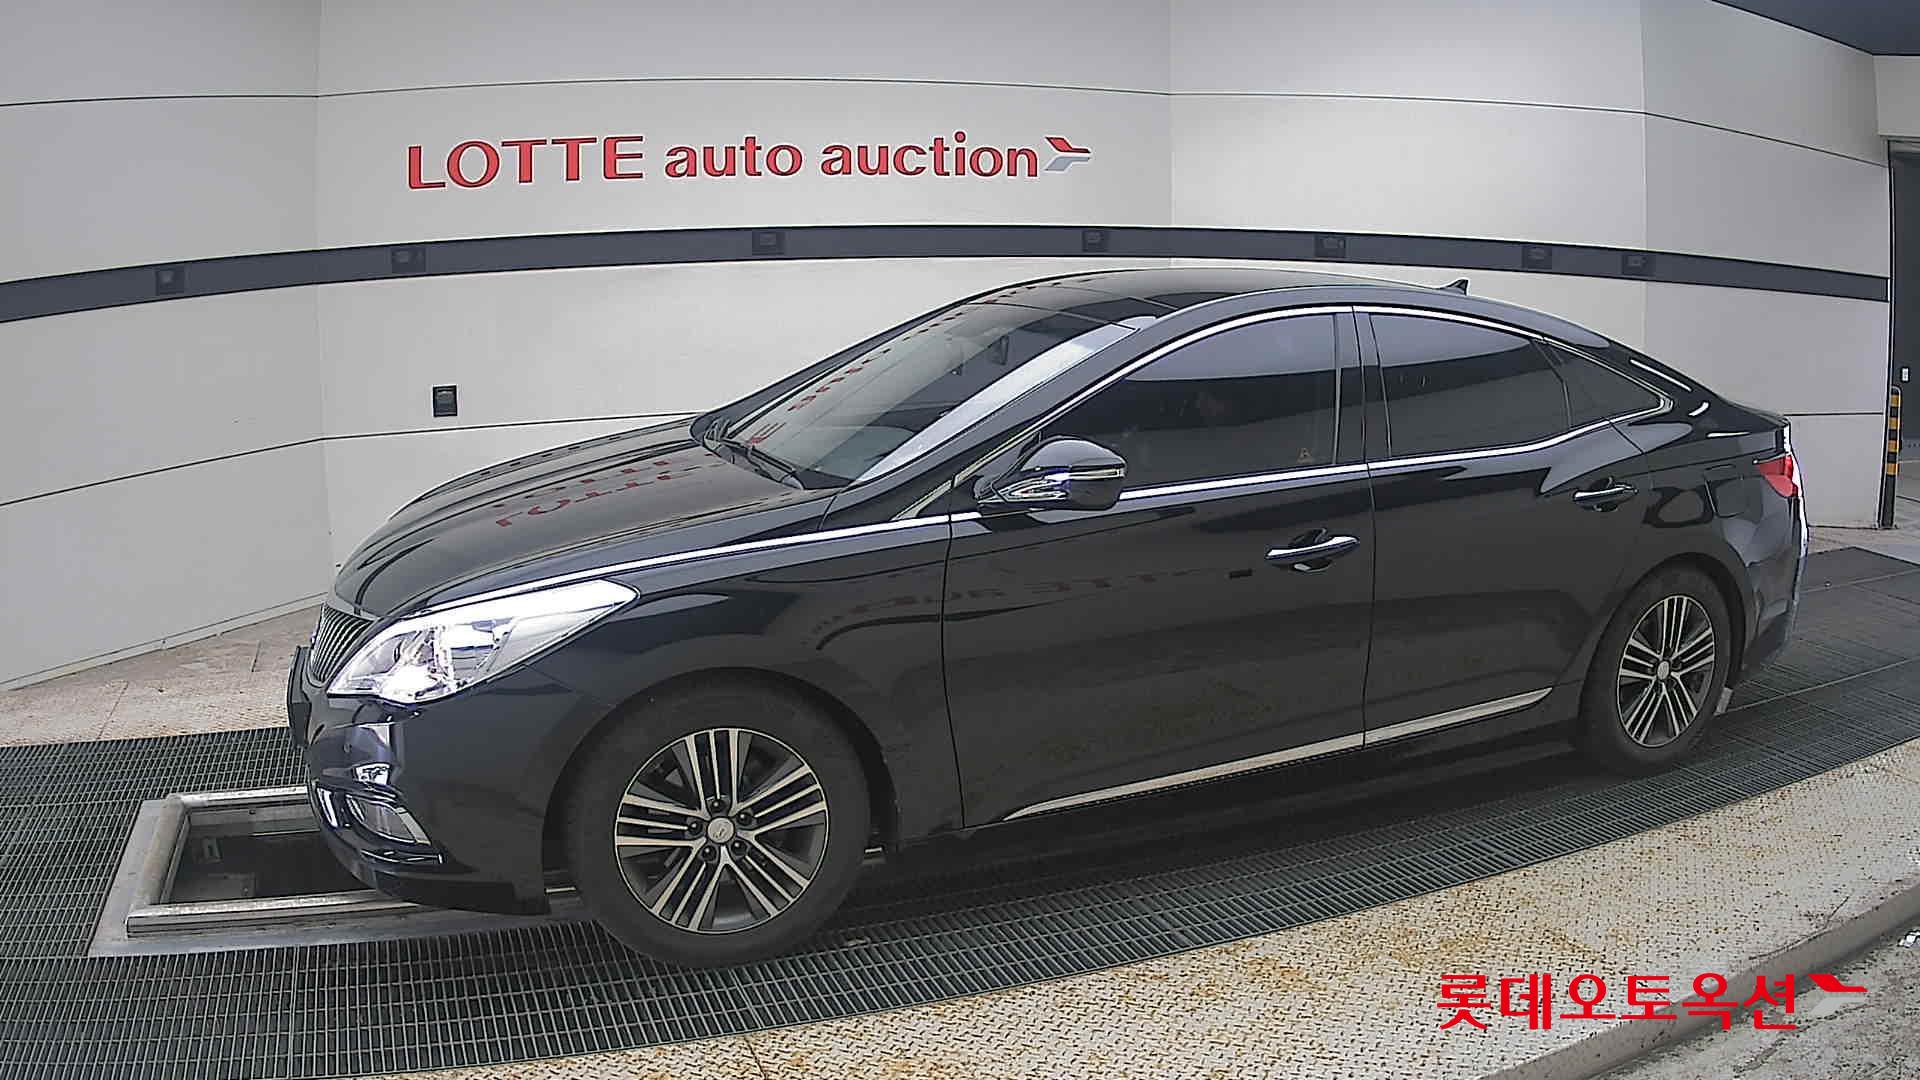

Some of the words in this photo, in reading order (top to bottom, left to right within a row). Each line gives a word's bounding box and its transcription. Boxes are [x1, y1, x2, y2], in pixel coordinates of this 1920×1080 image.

[407, 135, 644, 190] LOTTE
[665, 136, 803, 178] auto
[820, 131, 1039, 178] auction
